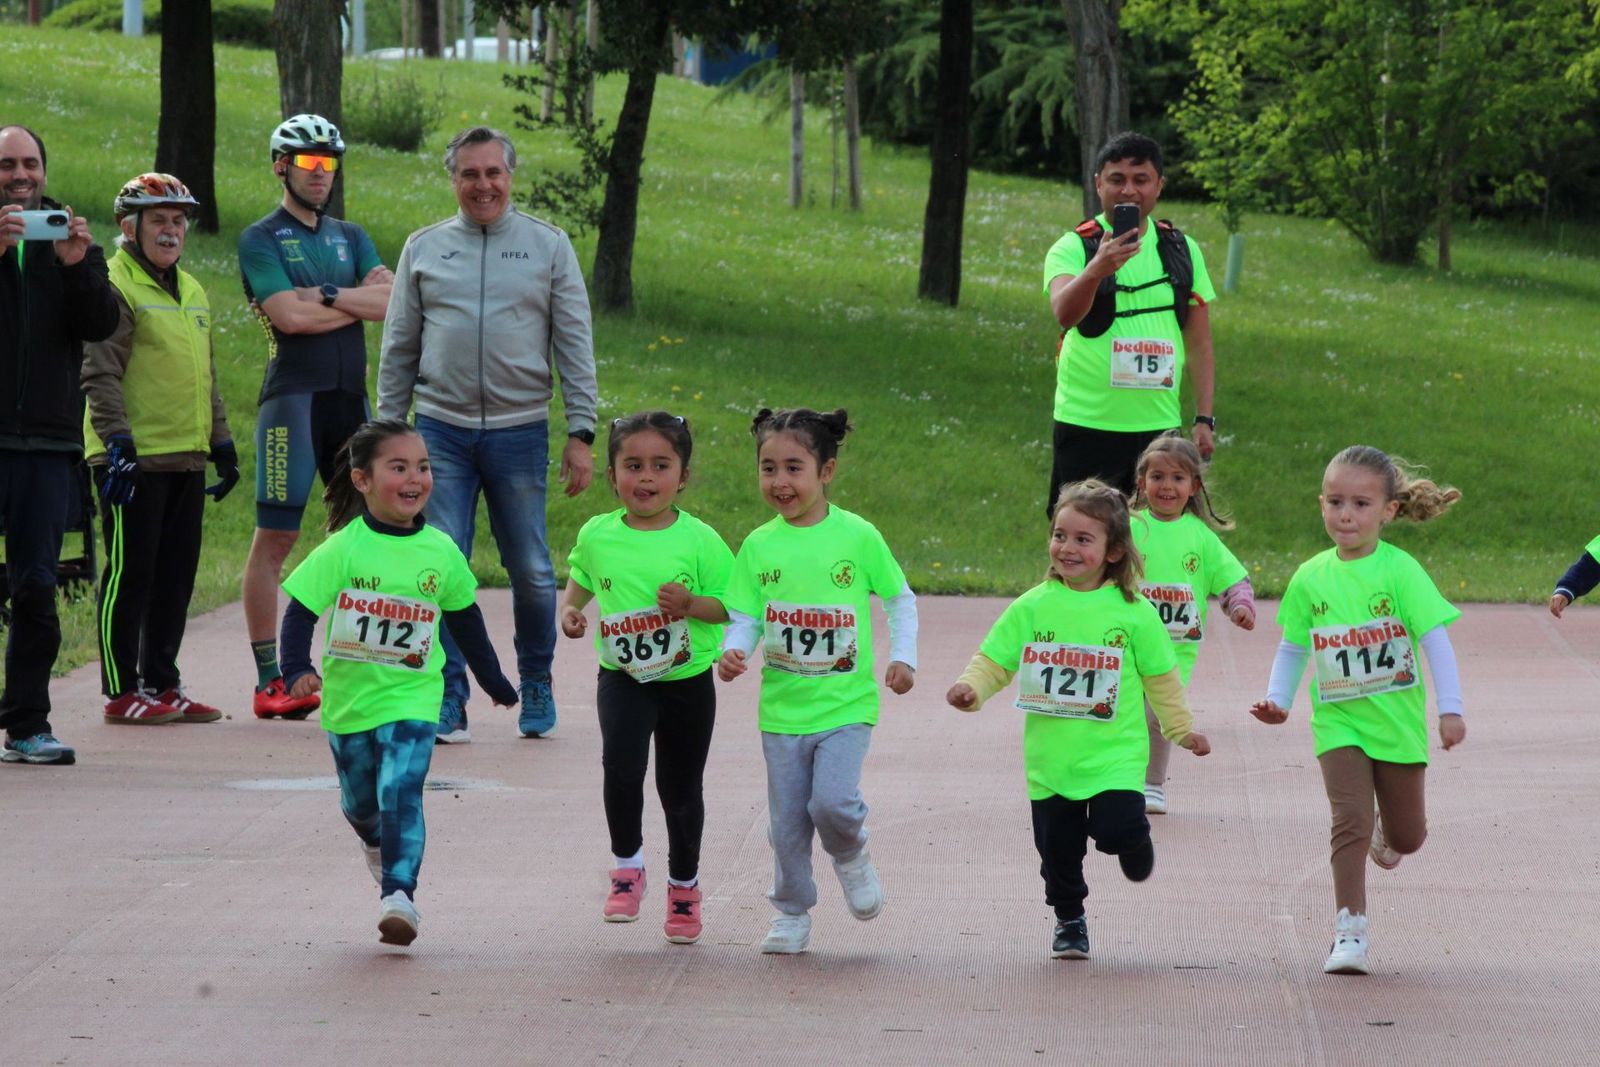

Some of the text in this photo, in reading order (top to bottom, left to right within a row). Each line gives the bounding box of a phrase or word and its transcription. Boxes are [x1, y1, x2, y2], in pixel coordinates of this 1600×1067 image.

[501, 251, 529, 260] RFEA
[1113, 341, 1174, 355] bedunia
[1134, 355, 1159, 373] 15
[266, 428, 274, 500] SALAMANCA
[275, 426, 288, 502] BICIGRUP
[338, 592, 435, 623] bedunia
[766, 607, 855, 628] bedunia
[1149, 600, 1190, 625] 04
[356, 615, 414, 649] 112
[615, 628, 671, 664] 369
[781, 627, 835, 656] 191
[1313, 622, 1407, 652] bedunia
[1023, 646, 1120, 671] bedunia
[1335, 642, 1396, 677] 114
[1040, 666, 1096, 698] 121
